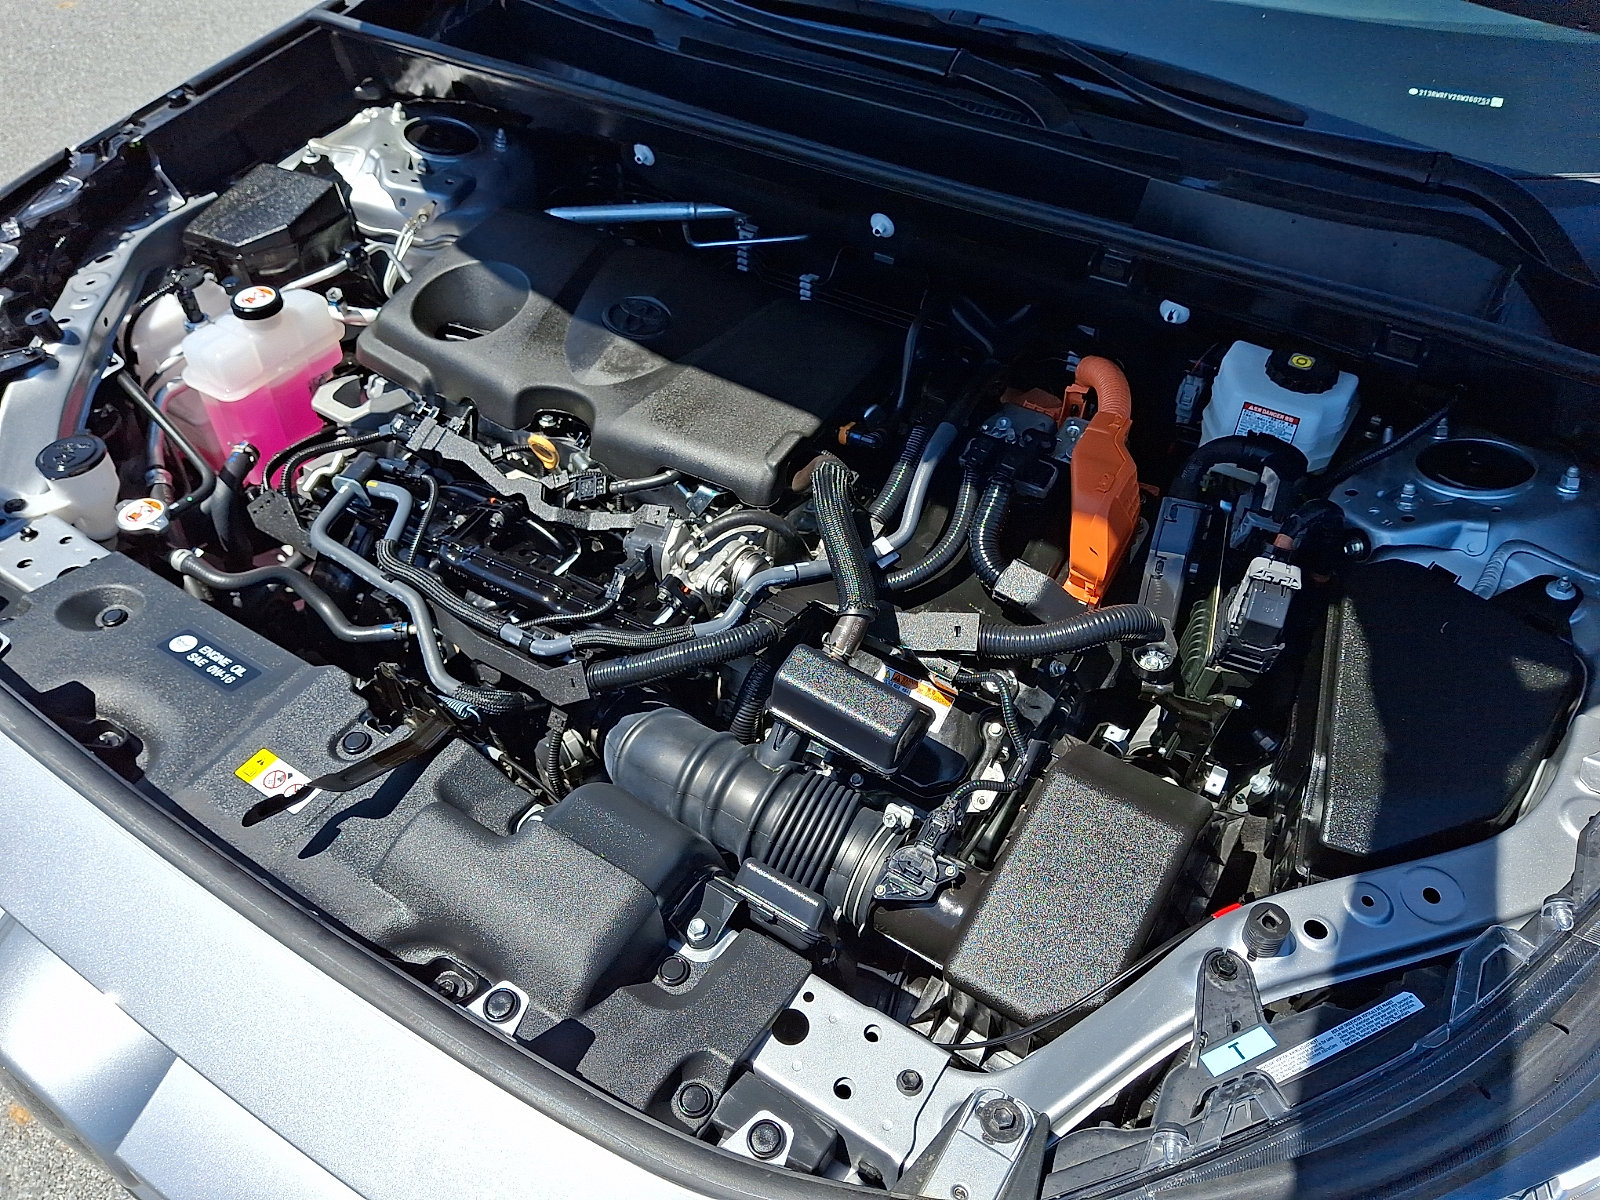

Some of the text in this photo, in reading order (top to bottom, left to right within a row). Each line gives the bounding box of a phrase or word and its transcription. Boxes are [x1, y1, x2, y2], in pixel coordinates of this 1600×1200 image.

[1262, 408, 1285, 420] DANGER
[186, 652, 236, 684] SAE 0W-16
[198, 645, 247, 678] ENGINE OIL
[1228, 1041, 1246, 1060] T
